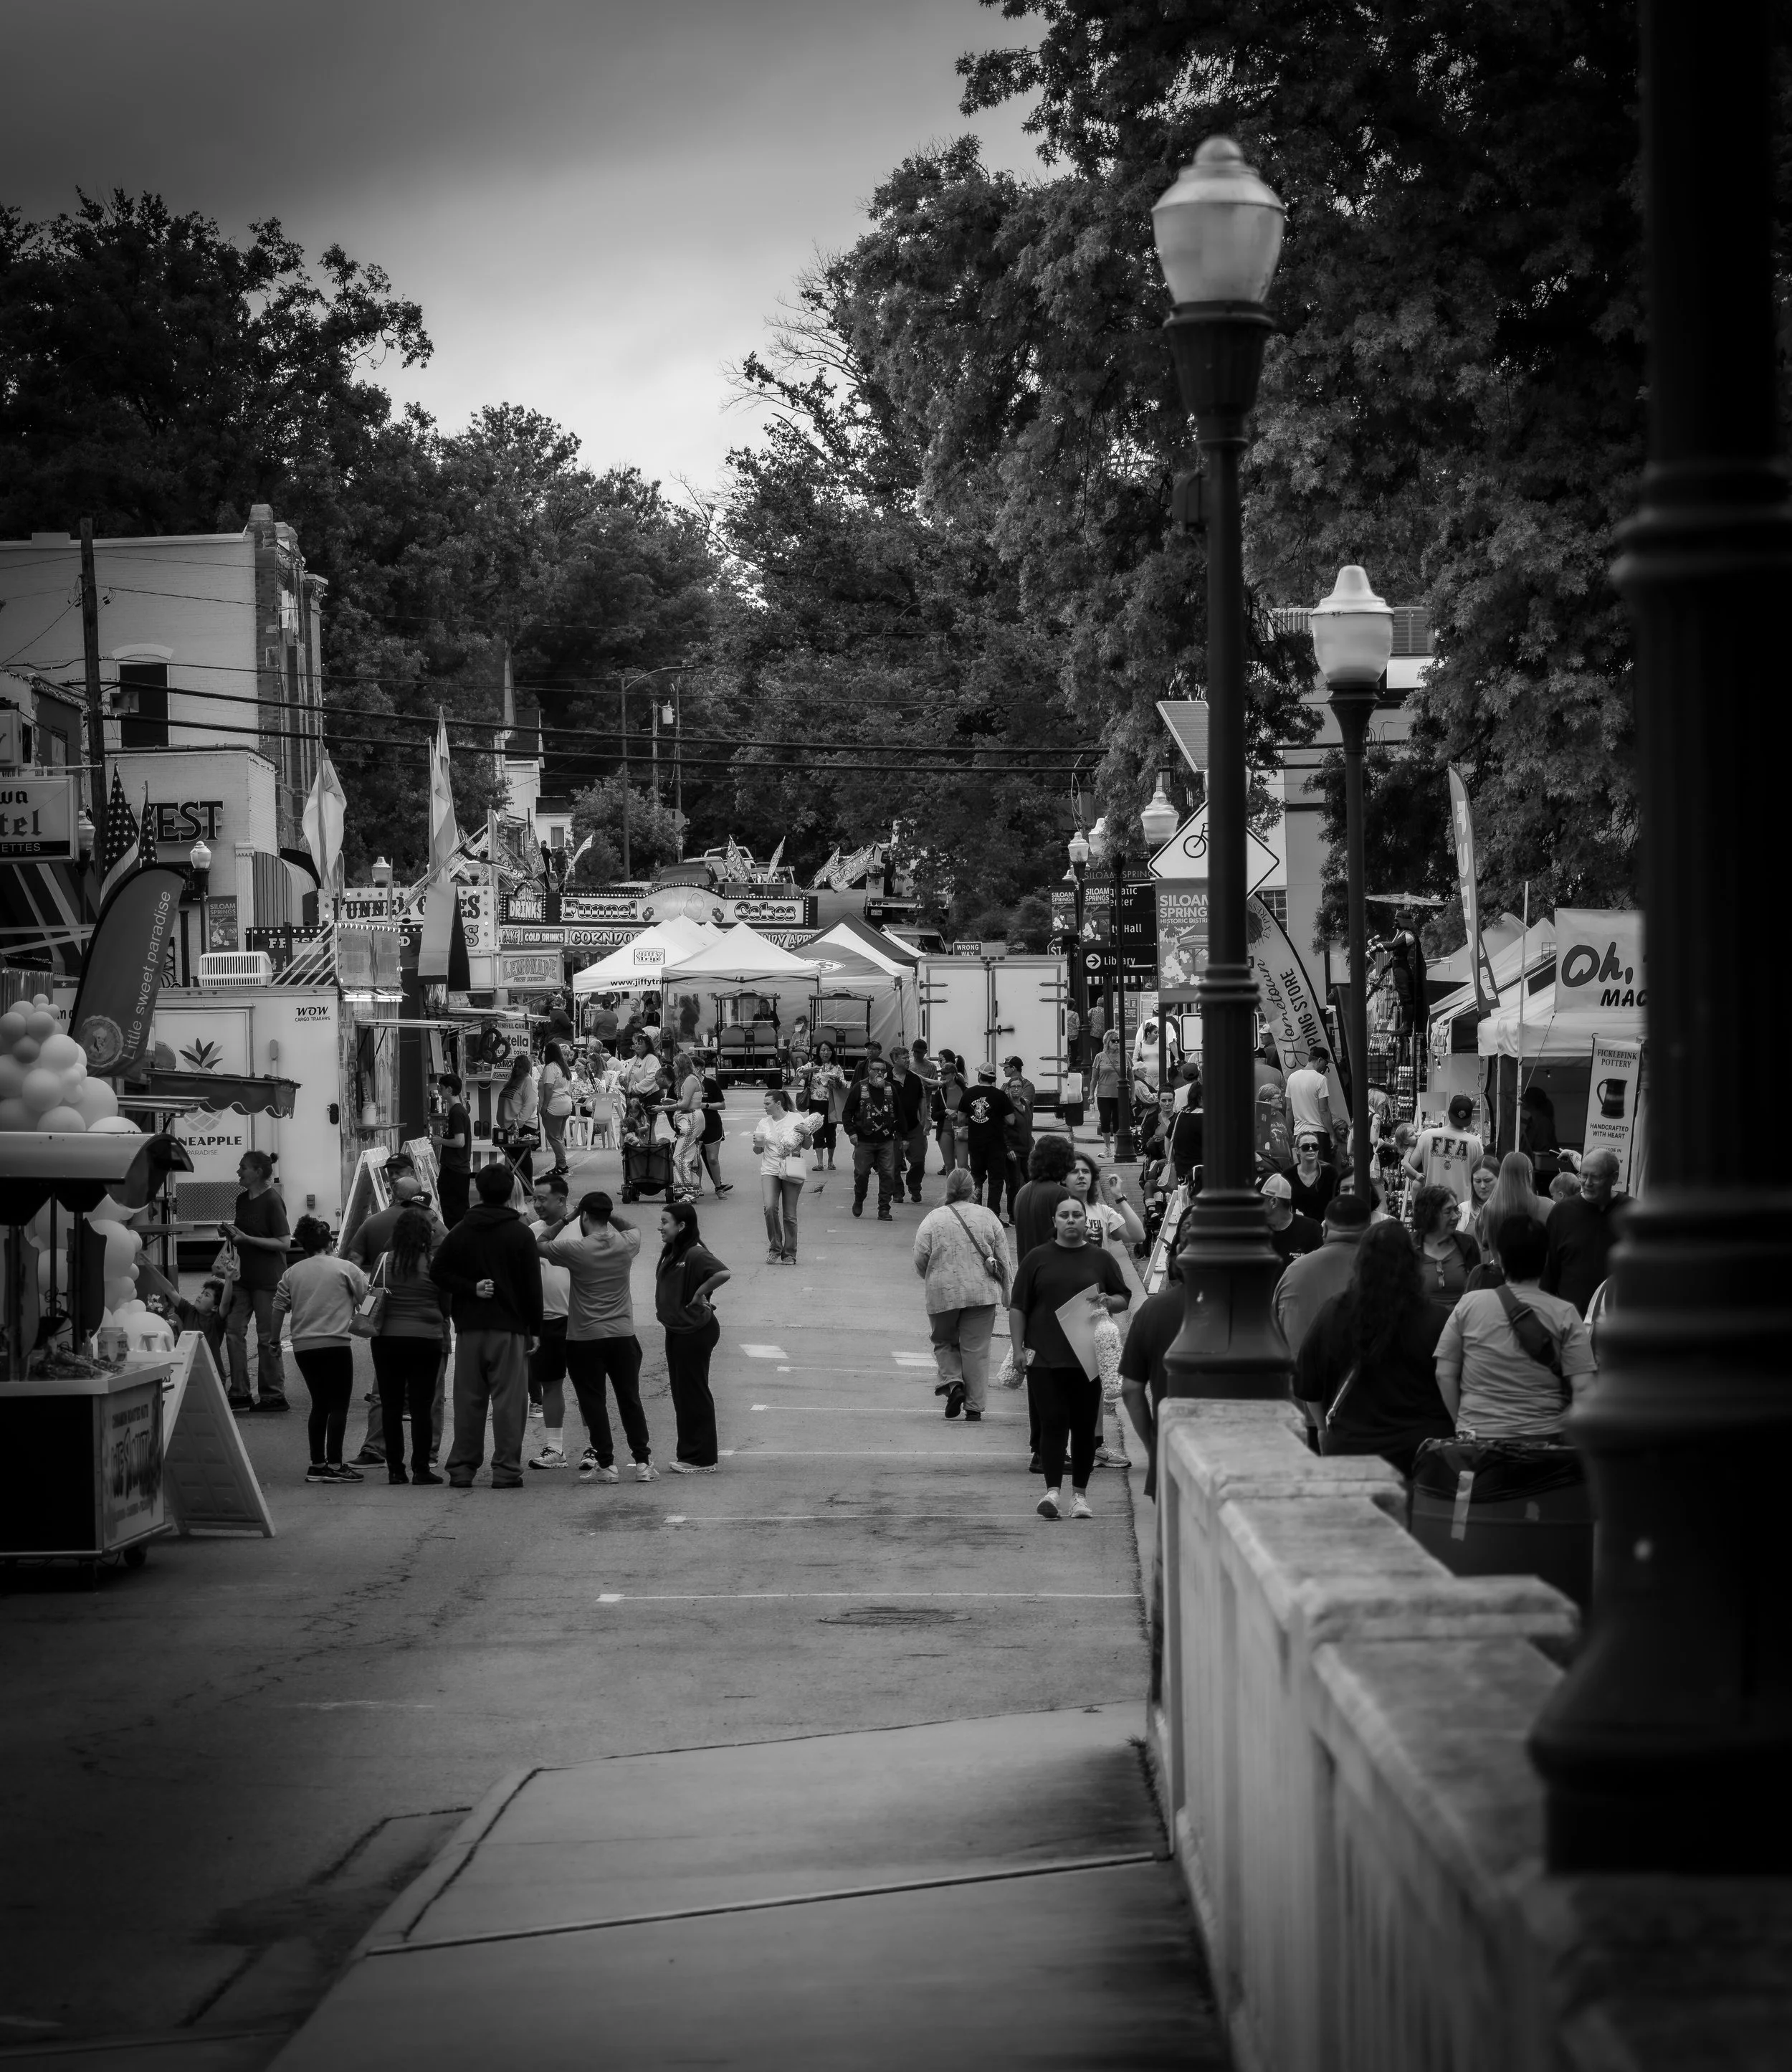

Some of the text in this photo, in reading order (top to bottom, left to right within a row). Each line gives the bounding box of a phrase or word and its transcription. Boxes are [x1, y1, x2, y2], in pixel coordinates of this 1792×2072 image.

[1, 843, 41, 852] ETTES
[1110, 887, 1138, 897] qatic
[417, 895, 482, 921] CES
[509, 900, 543, 919] DRINKS
[563, 898, 638, 920] Funnel
[734, 901, 796, 921] Cakes
[1249, 902, 1272, 939] EXPRESS
[1125, 924, 1142, 933] Hall
[502, 930, 519, 945] CAKE
[524, 932, 564, 944] COLD DRINKS
[788, 934, 813, 948] APP
[1104, 956, 1136, 966] Libary
[1561, 941, 1634, 988] Oh,
[123, 891, 171, 1060] Little sweet paradise
[503, 958, 557, 981] LEMONADE
[1280, 969, 1308, 1012] STORE
[296, 1007, 329, 1016] WOW
[1257, 959, 1311, 1070] Hometown
[1597, 1050, 1637, 1060] FICKLEFINK
[1601, 1058, 1632, 1068] POTTERY
[1590, 1123, 1629, 1132] HANDCRAFTED
[178, 1136, 242, 1146] NEAPPLE
[1431, 1136, 1468, 1157] FFA
